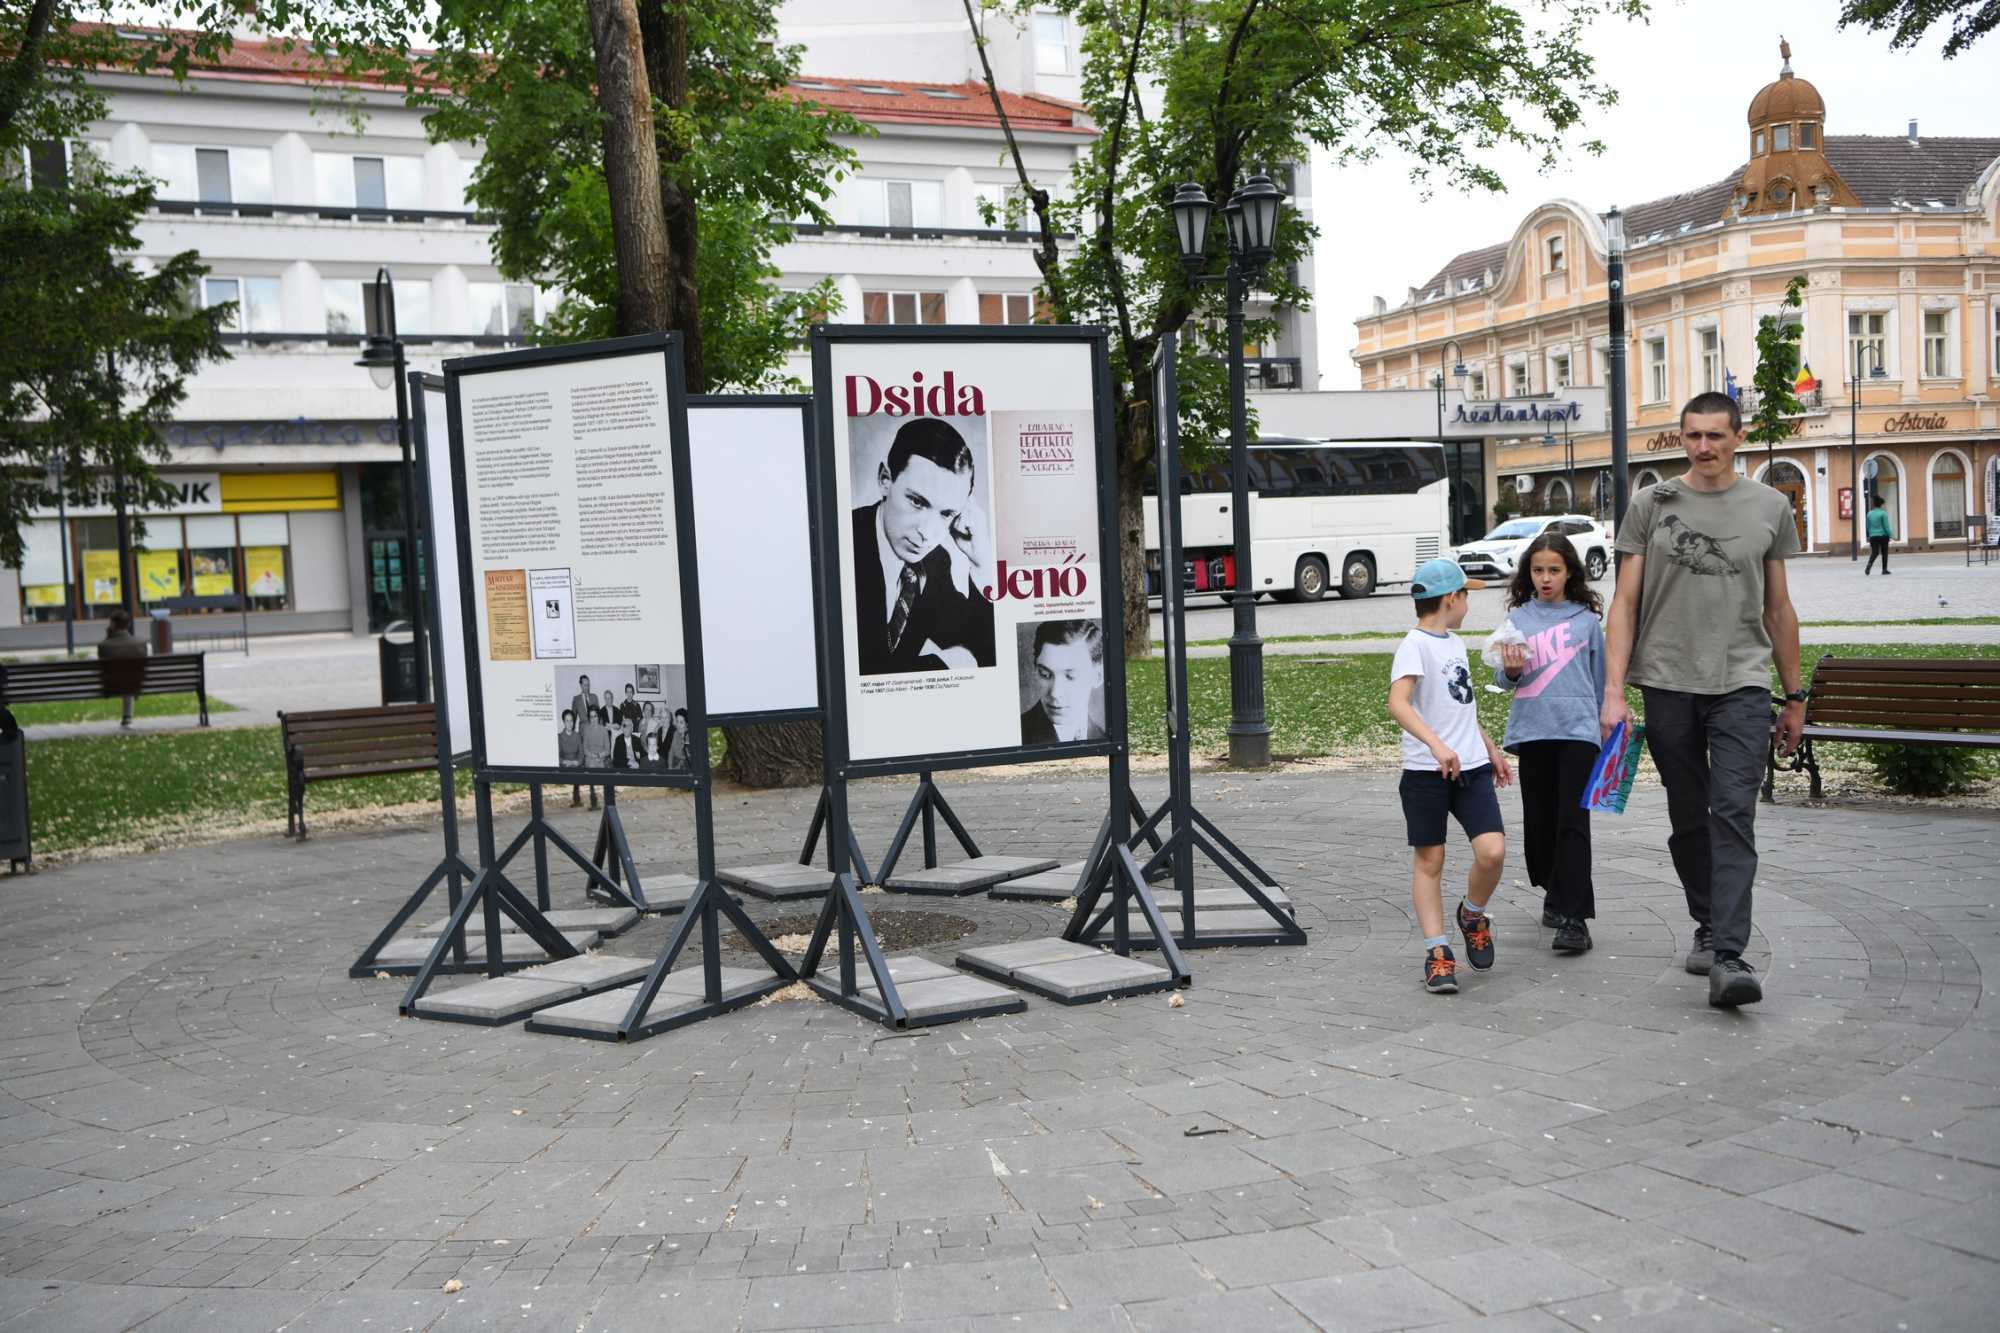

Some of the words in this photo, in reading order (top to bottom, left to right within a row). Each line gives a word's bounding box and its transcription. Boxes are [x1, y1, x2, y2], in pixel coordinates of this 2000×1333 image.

[845, 371, 985, 417] Dsida
[1884, 411, 1948, 433] Astoria
[983, 553, 1087, 603] Jenő
